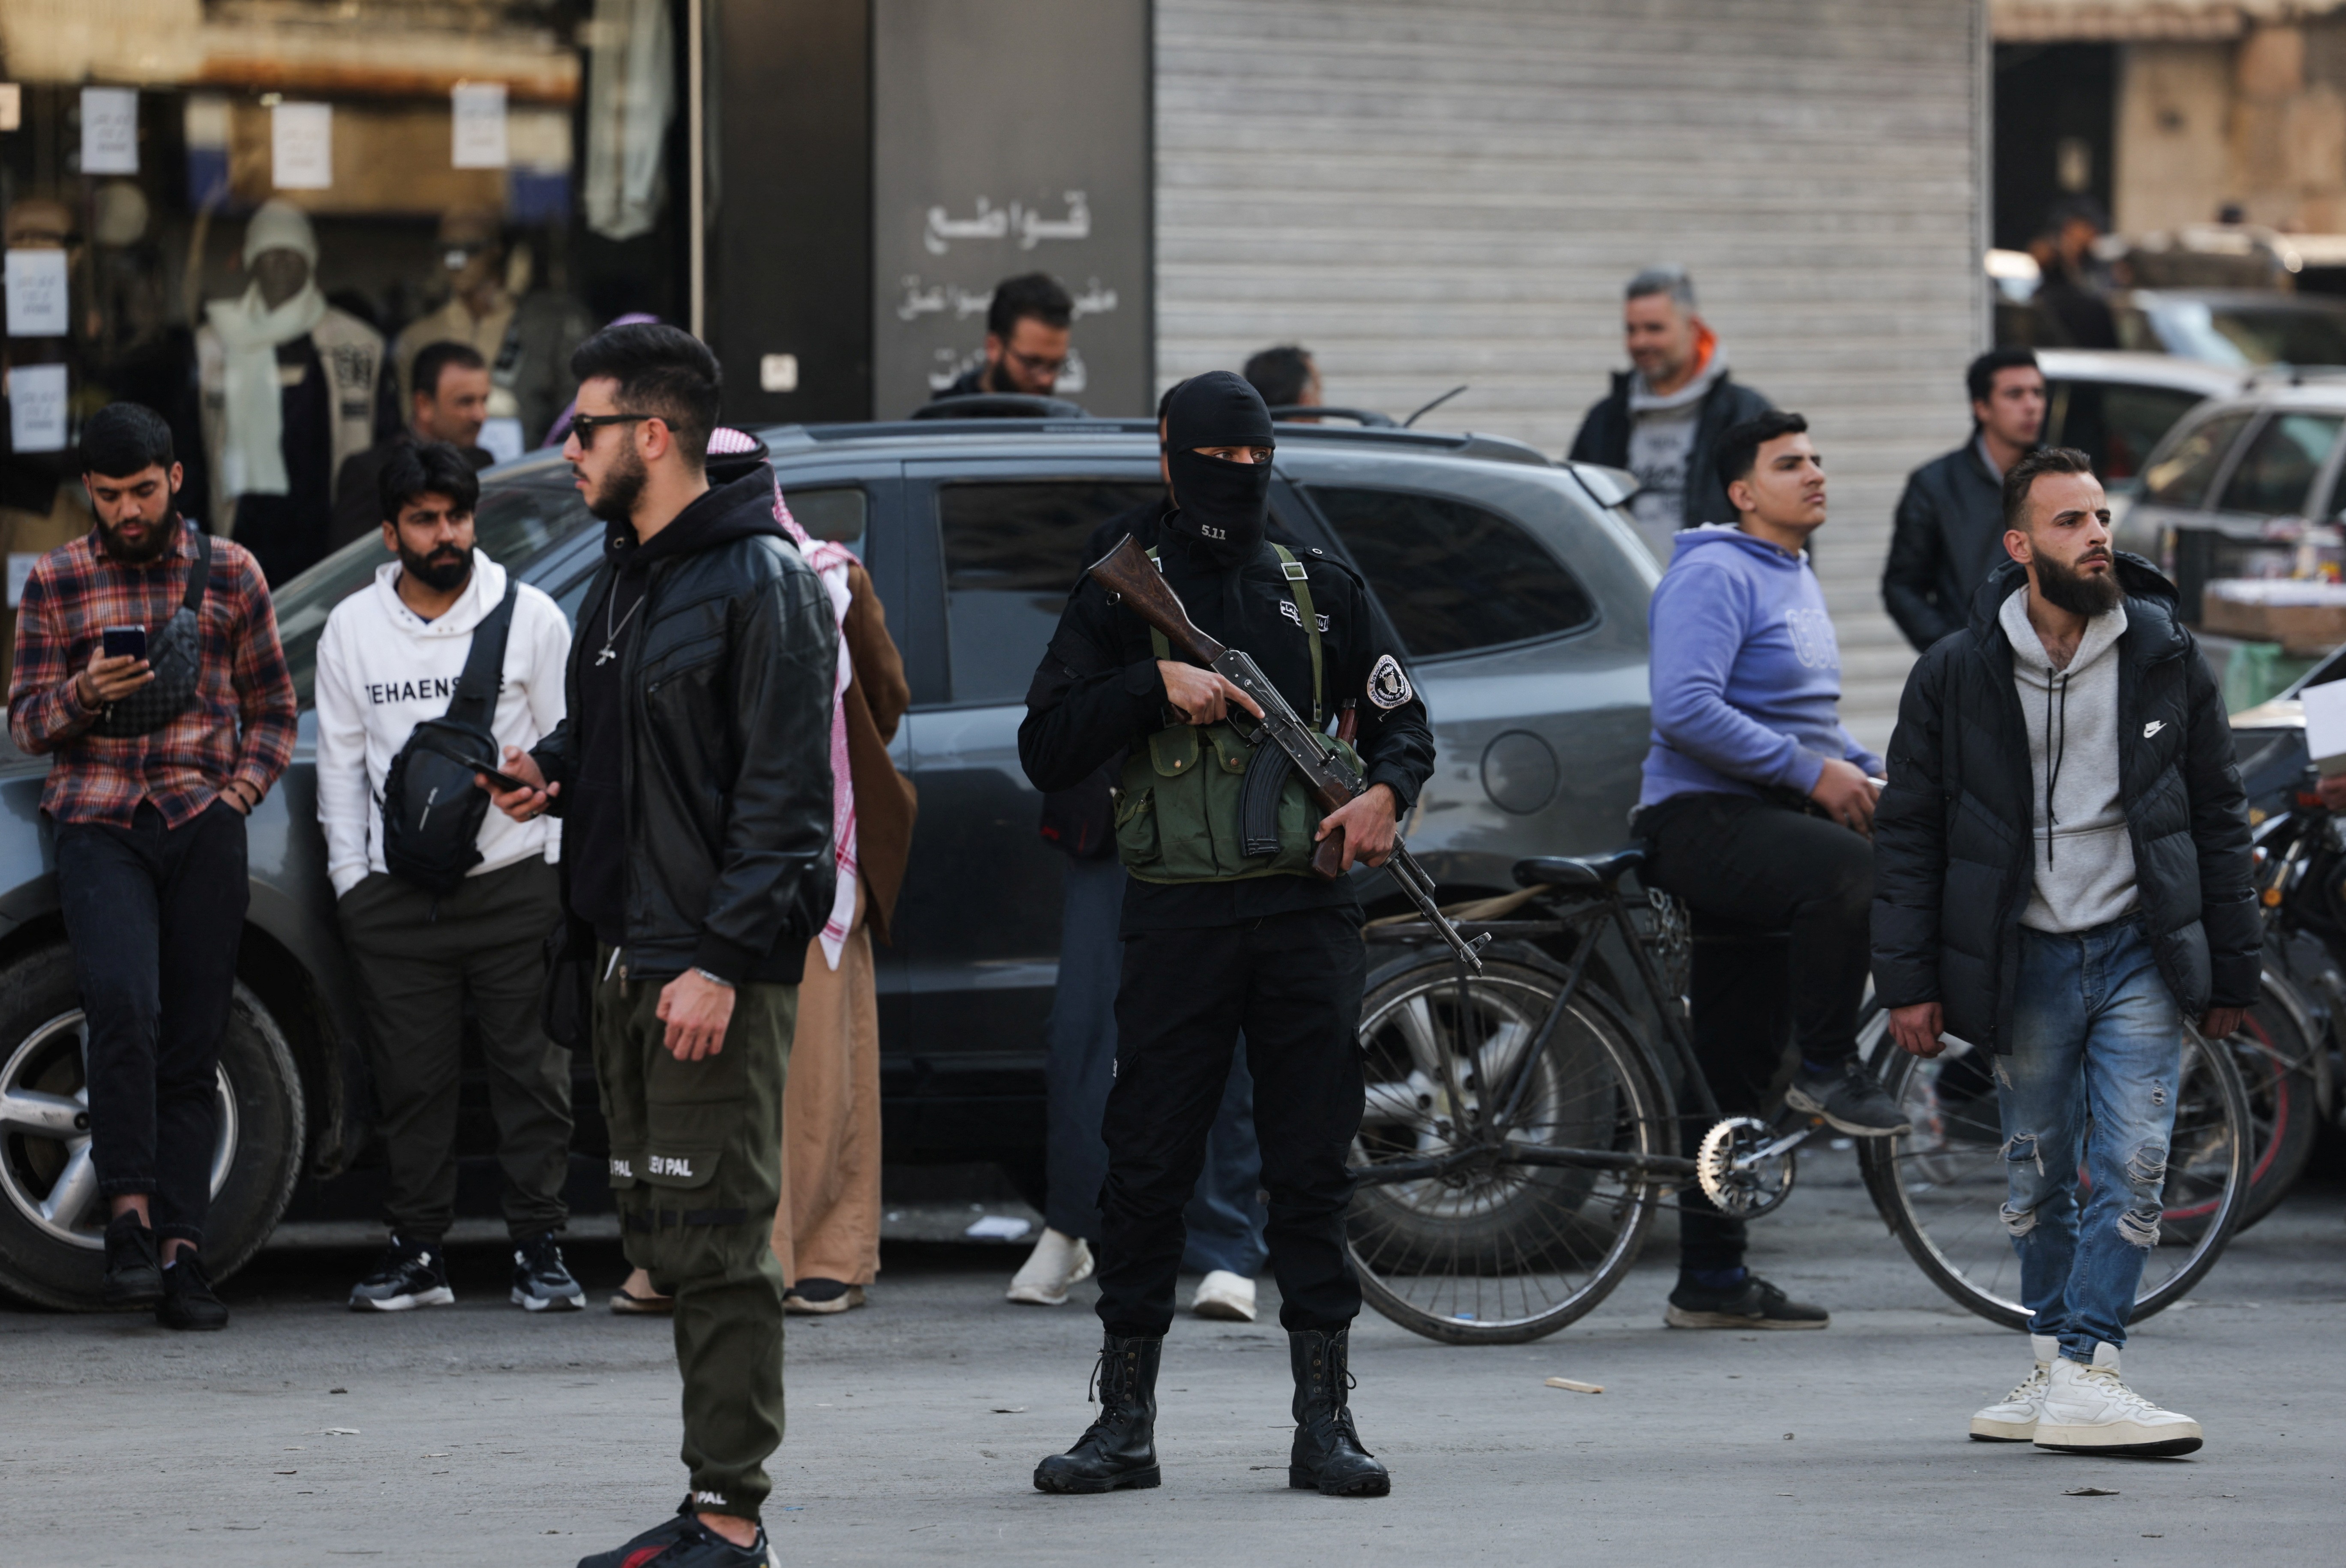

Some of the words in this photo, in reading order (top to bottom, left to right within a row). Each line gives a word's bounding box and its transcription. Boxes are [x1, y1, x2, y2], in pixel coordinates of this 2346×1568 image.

[1201, 524, 1226, 540] 5.11
[665, 1158, 693, 1177] PAL
[697, 1490, 727, 1505] PAL
